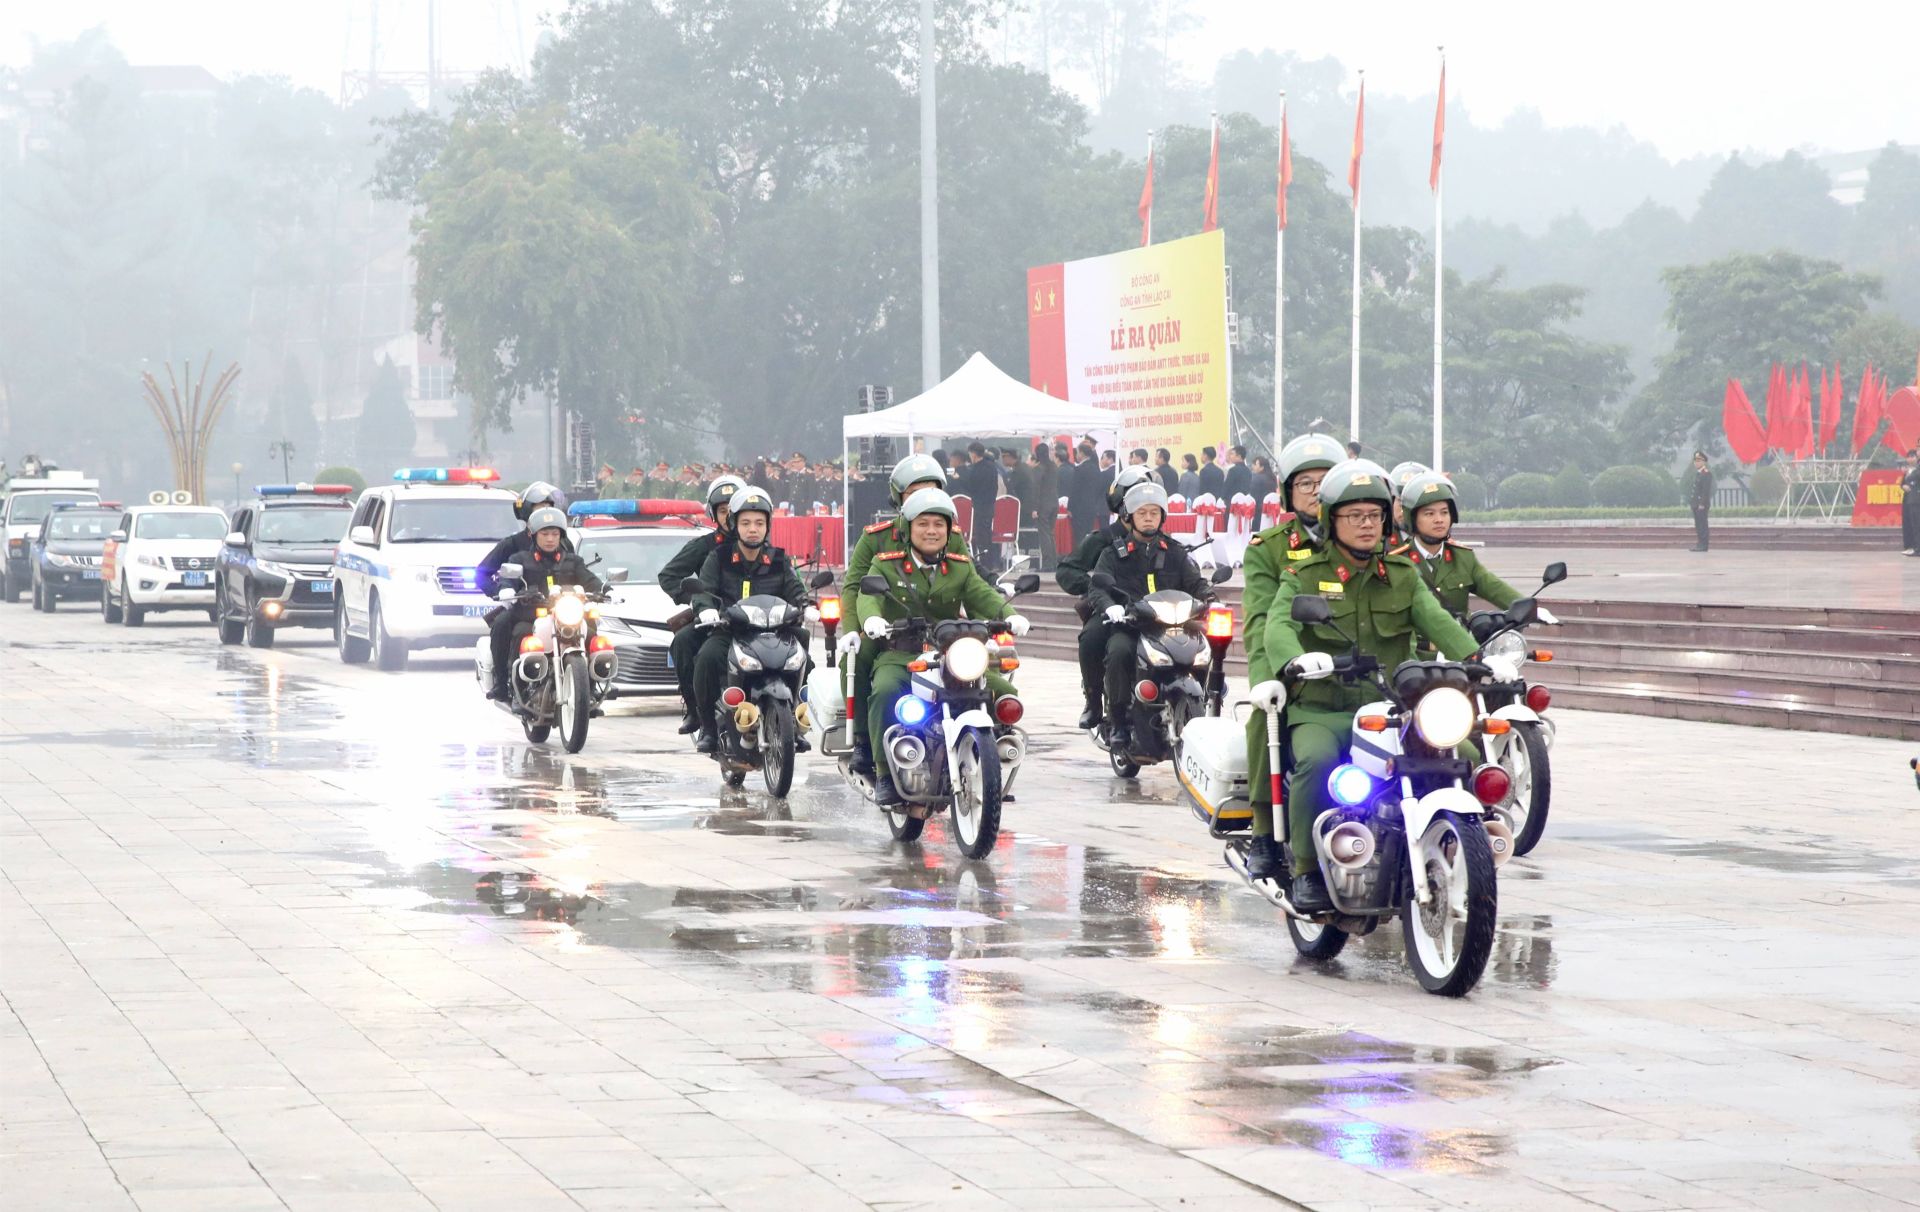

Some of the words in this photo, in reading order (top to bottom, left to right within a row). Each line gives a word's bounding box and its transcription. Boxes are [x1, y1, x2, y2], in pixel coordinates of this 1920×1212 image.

[1139, 273, 1152, 286] CÔNG
[1154, 274, 1160, 283] AN
[1120, 294, 1134, 307] CÔNG
[1134, 296, 1141, 304] AN
[1128, 325, 1145, 349] RA
[1148, 316, 1180, 352] QUÂN
[466, 606, 496, 617] 21A-0
[1186, 755, 1210, 792] CSTT
